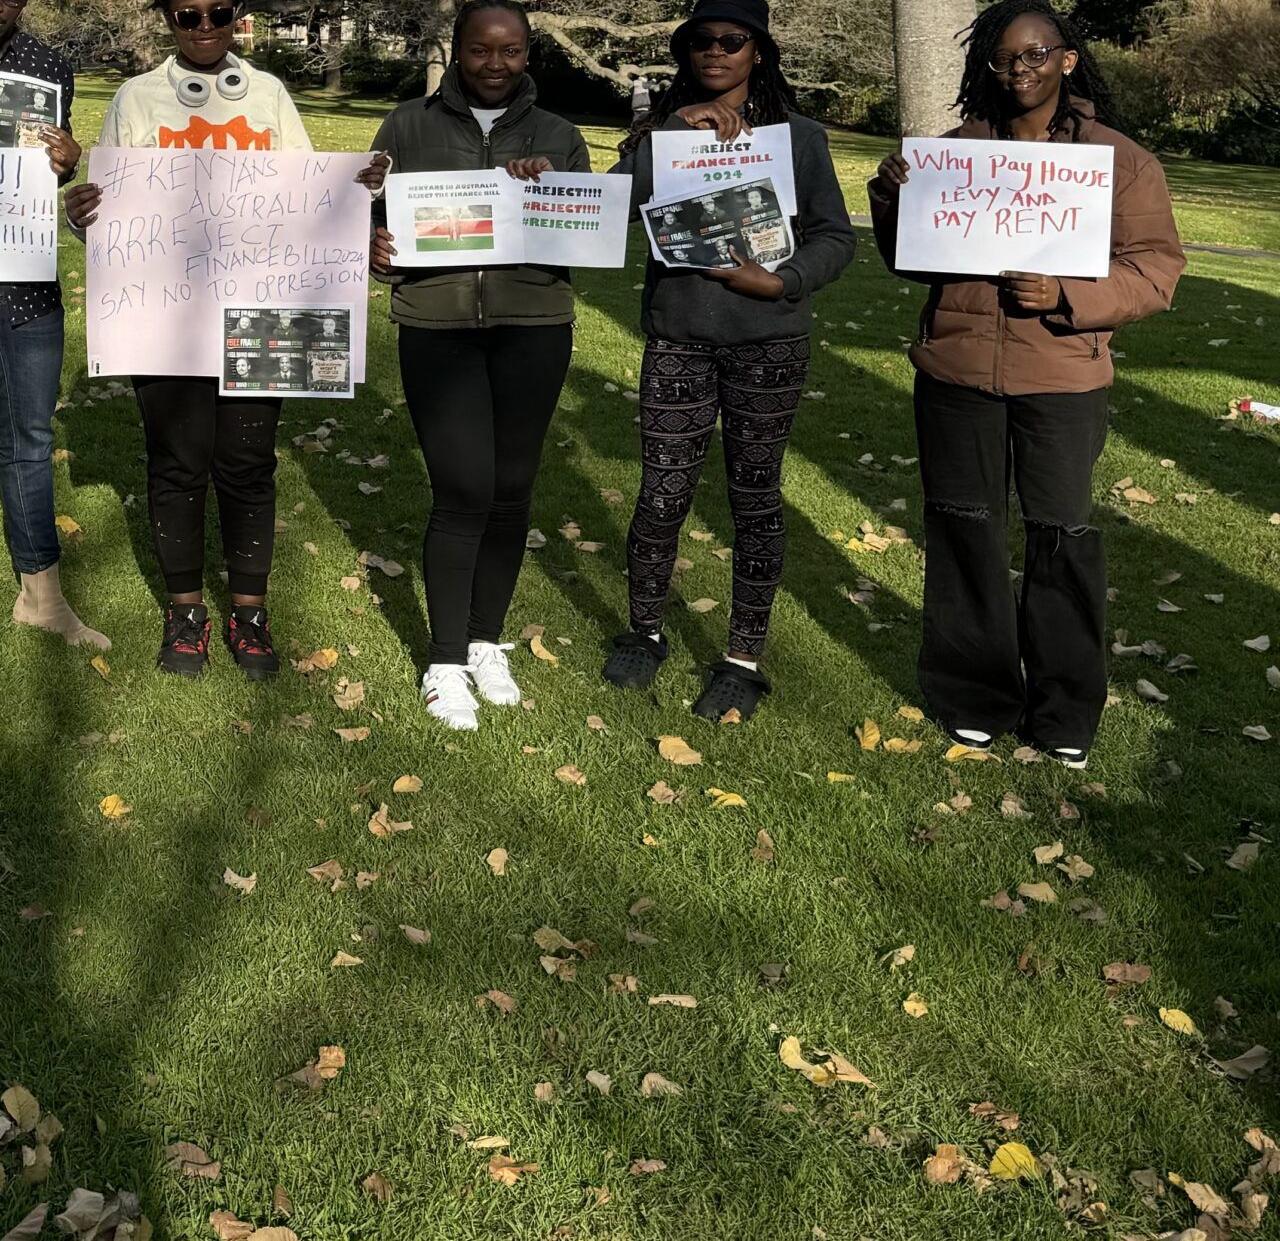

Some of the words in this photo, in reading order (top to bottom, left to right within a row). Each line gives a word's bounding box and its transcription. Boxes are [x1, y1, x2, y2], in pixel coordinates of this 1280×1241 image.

[691, 142, 752, 155] #REJECT
[671, 156, 736, 170] FINANCE
[739, 153, 774, 165] BILL
[102, 152, 279, 198] #KENYANS
[303, 157, 331, 181] IN
[703, 170, 743, 182] 2024
[913, 149, 973, 190] Why
[988, 154, 1033, 192] Pay
[1041, 160, 1110, 188] HOUSE
[455, 182, 499, 191] AUSTRALIA
[524, 185, 602, 198] #REJECT!!!!
[188, 189, 333, 219] AUSTRALIA
[941, 186, 1001, 212] LEVY
[522, 201, 601, 215] #REJECT!!!!
[522, 217, 600, 231] #REJECT!!!!
[933, 210, 978, 238] PAY
[995, 207, 1083, 238] RENT
[100, 281, 147, 320] SAY
[163, 283, 192, 308] NO
[207, 279, 238, 302] TO
[255, 265, 366, 303] OPPRESION
